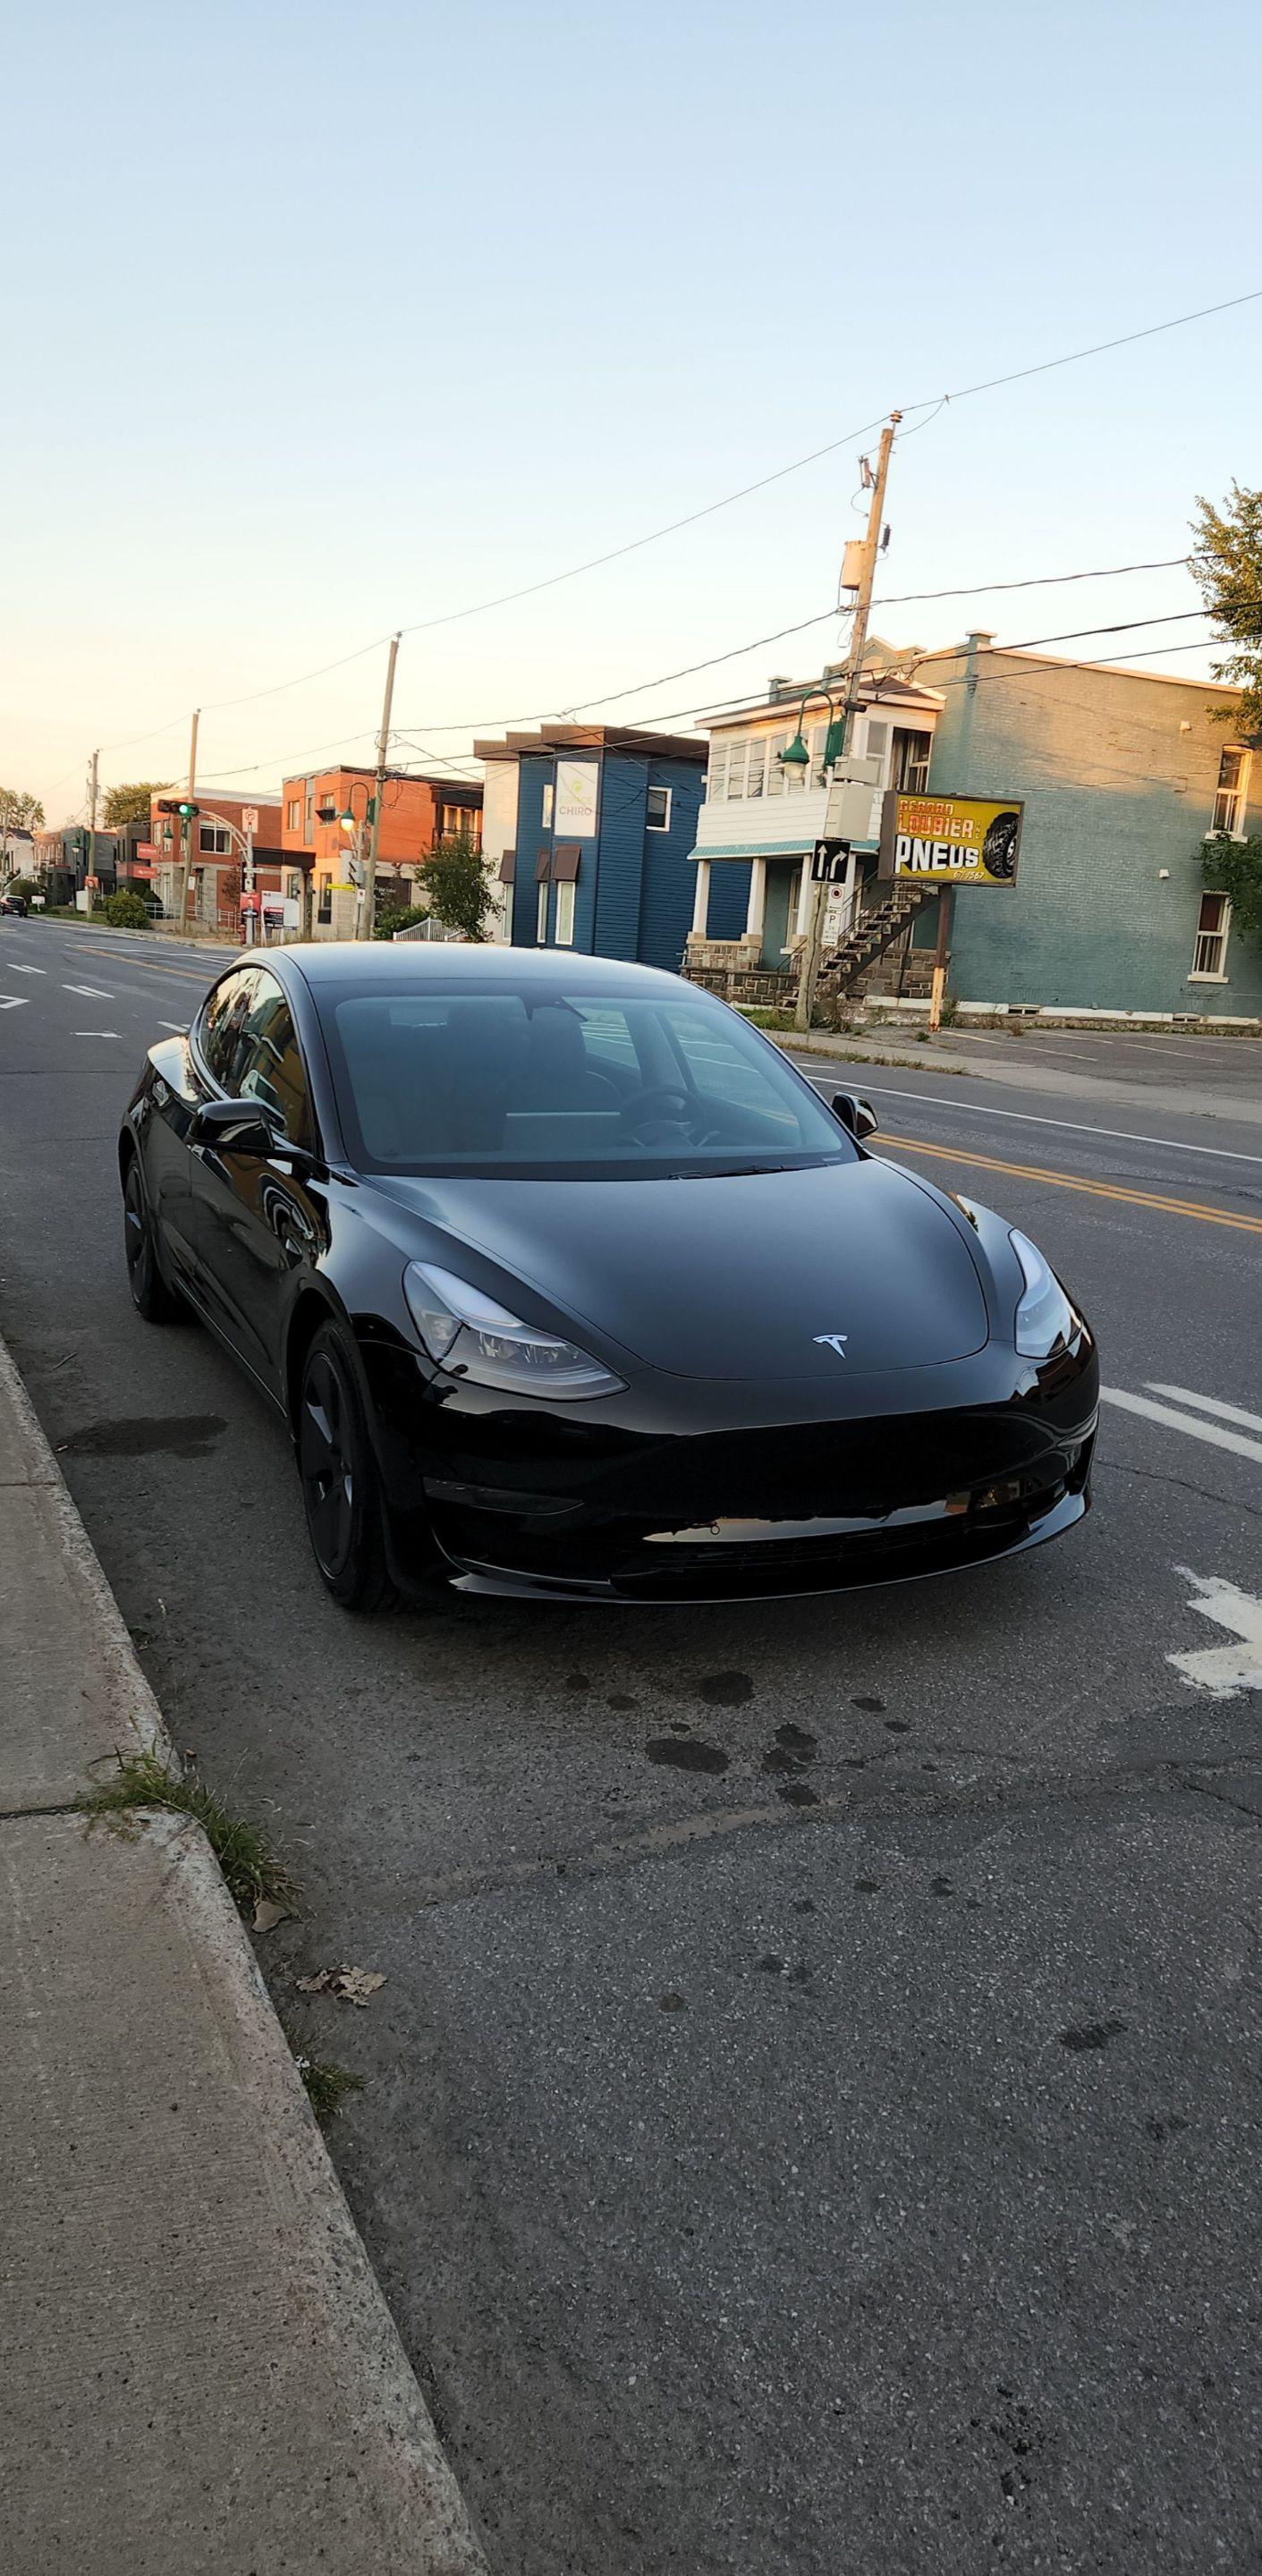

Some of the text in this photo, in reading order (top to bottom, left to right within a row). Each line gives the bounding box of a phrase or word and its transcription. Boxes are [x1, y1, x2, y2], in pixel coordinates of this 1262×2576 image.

[559, 806, 592, 817] CHIRO
[898, 813, 974, 839] LOUBIER
[894, 835, 980, 874] PNEUS
[829, 915, 835, 923] P
